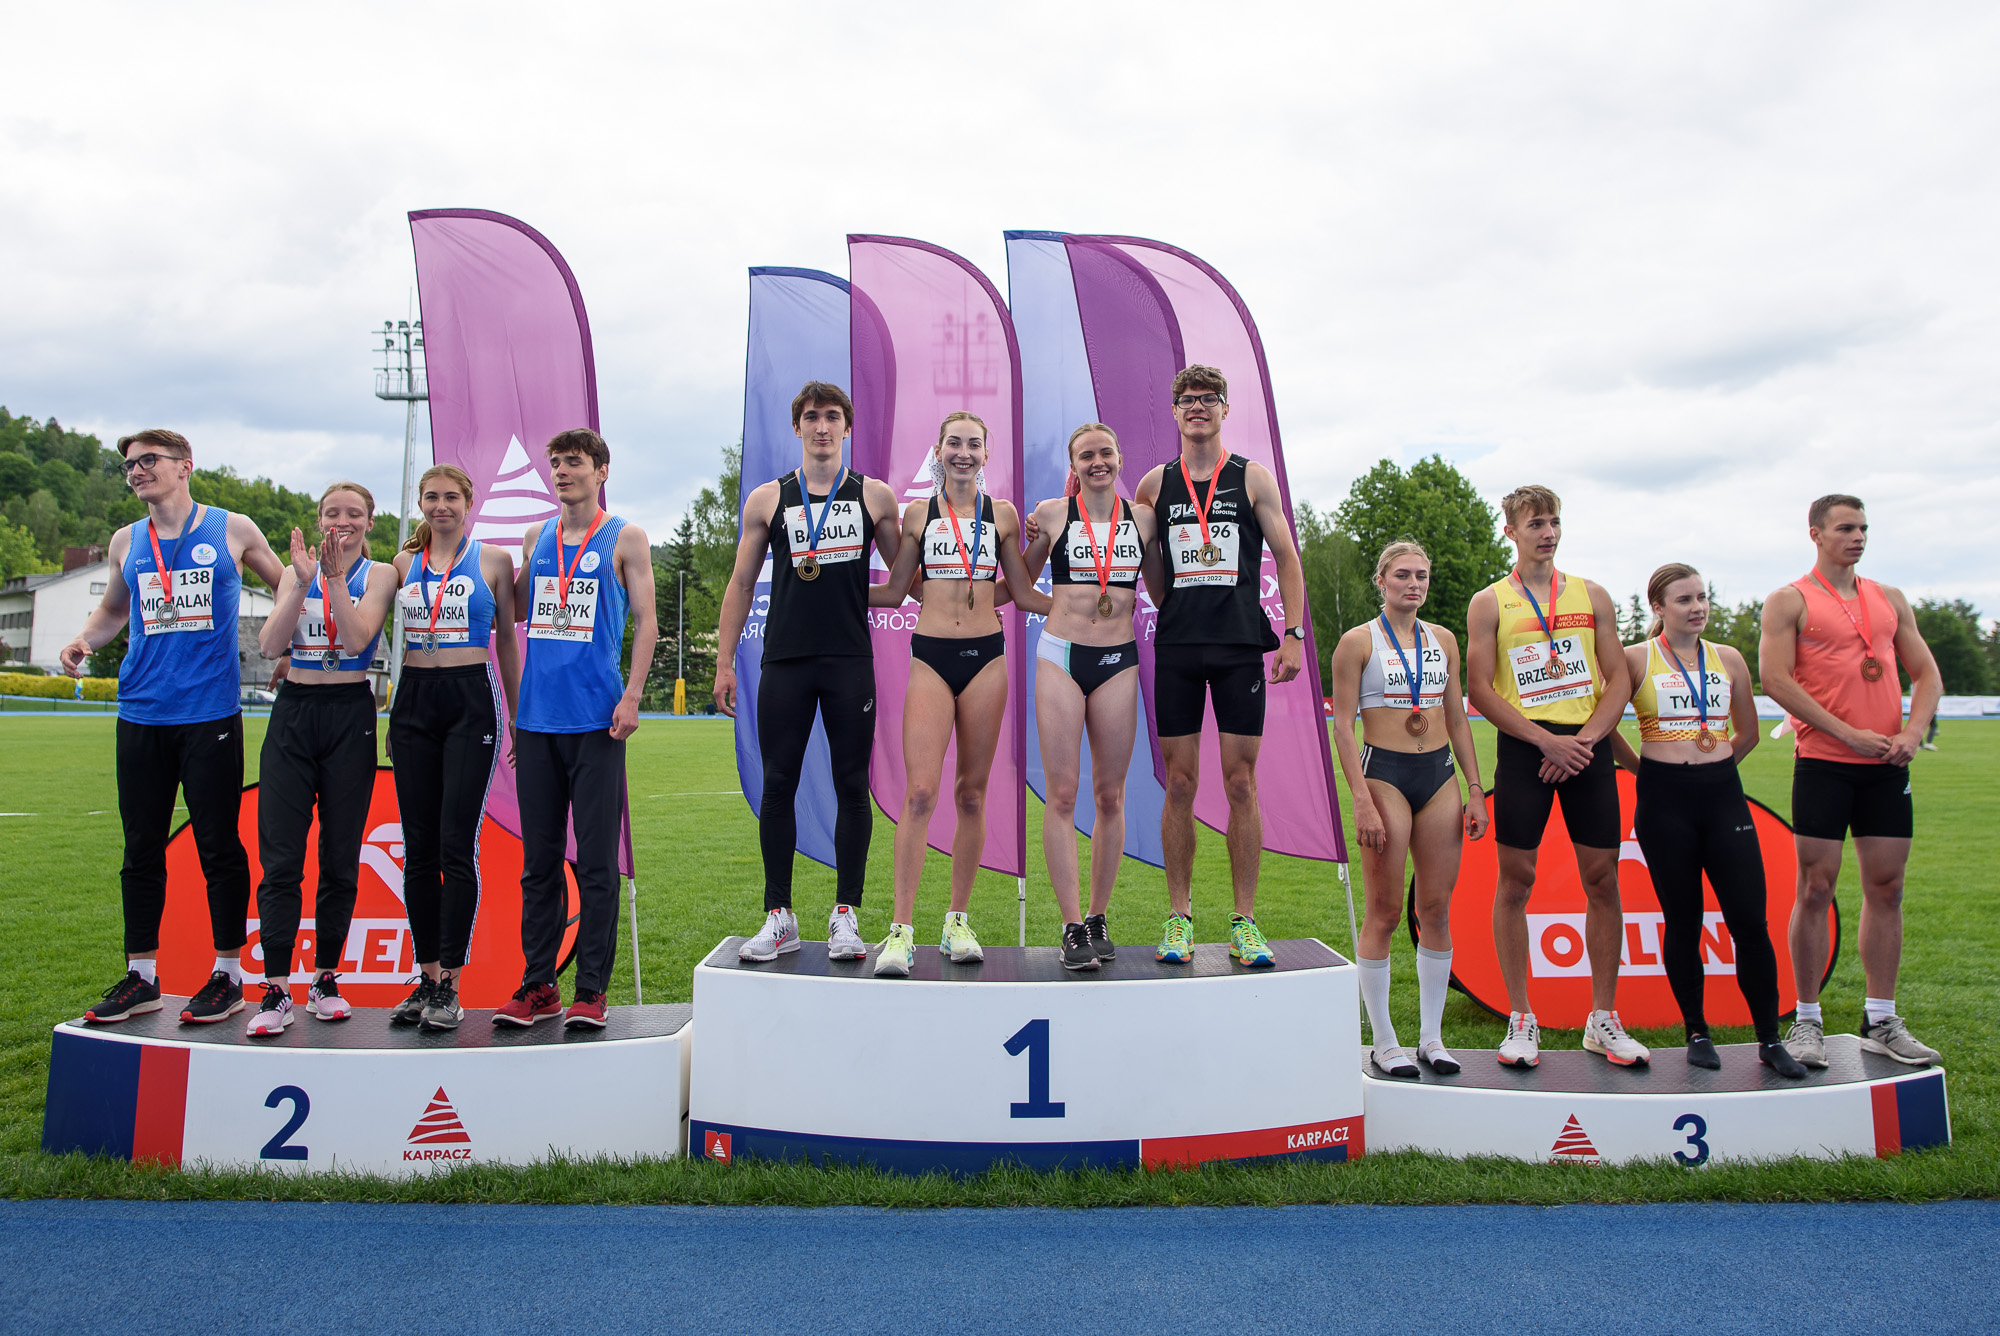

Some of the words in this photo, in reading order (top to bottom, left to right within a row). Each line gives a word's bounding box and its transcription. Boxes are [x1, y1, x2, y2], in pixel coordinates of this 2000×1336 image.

[831, 503, 852, 516] 94
[794, 524, 858, 544] BBULA
[970, 521, 988, 536] 98
[1211, 524, 1231, 539] 96
[802, 552, 832, 561] PACZ
[933, 542, 989, 557] KLAMA
[1181, 548, 1226, 564] BRL
[180, 570, 210, 586] 138
[436, 583, 466, 597] 40
[567, 580, 594, 595] 136
[402, 606, 465, 620] TWARDWSKA
[147, 622, 179, 631] KARPACZ
[1555, 620, 1589, 628] WROCŁAW
[1555, 639, 1572, 655] 19
[1422, 649, 1441, 662] 25
[1518, 654, 1539, 664] ORLEN
[1517, 659, 1587, 687] BRZESKI
[1530, 692, 1561, 703] KARPACZ
[1562, 689, 1578, 697] 2022
[1541, 922, 1735, 967] OLN
[1003, 1019, 1065, 1118] 1
[259, 1085, 310, 1160] 2
[1287, 1126, 1349, 1149] KARPACZ
[1673, 1113, 1709, 1167] 3
[402, 1148, 472, 1161] KARPACZ
